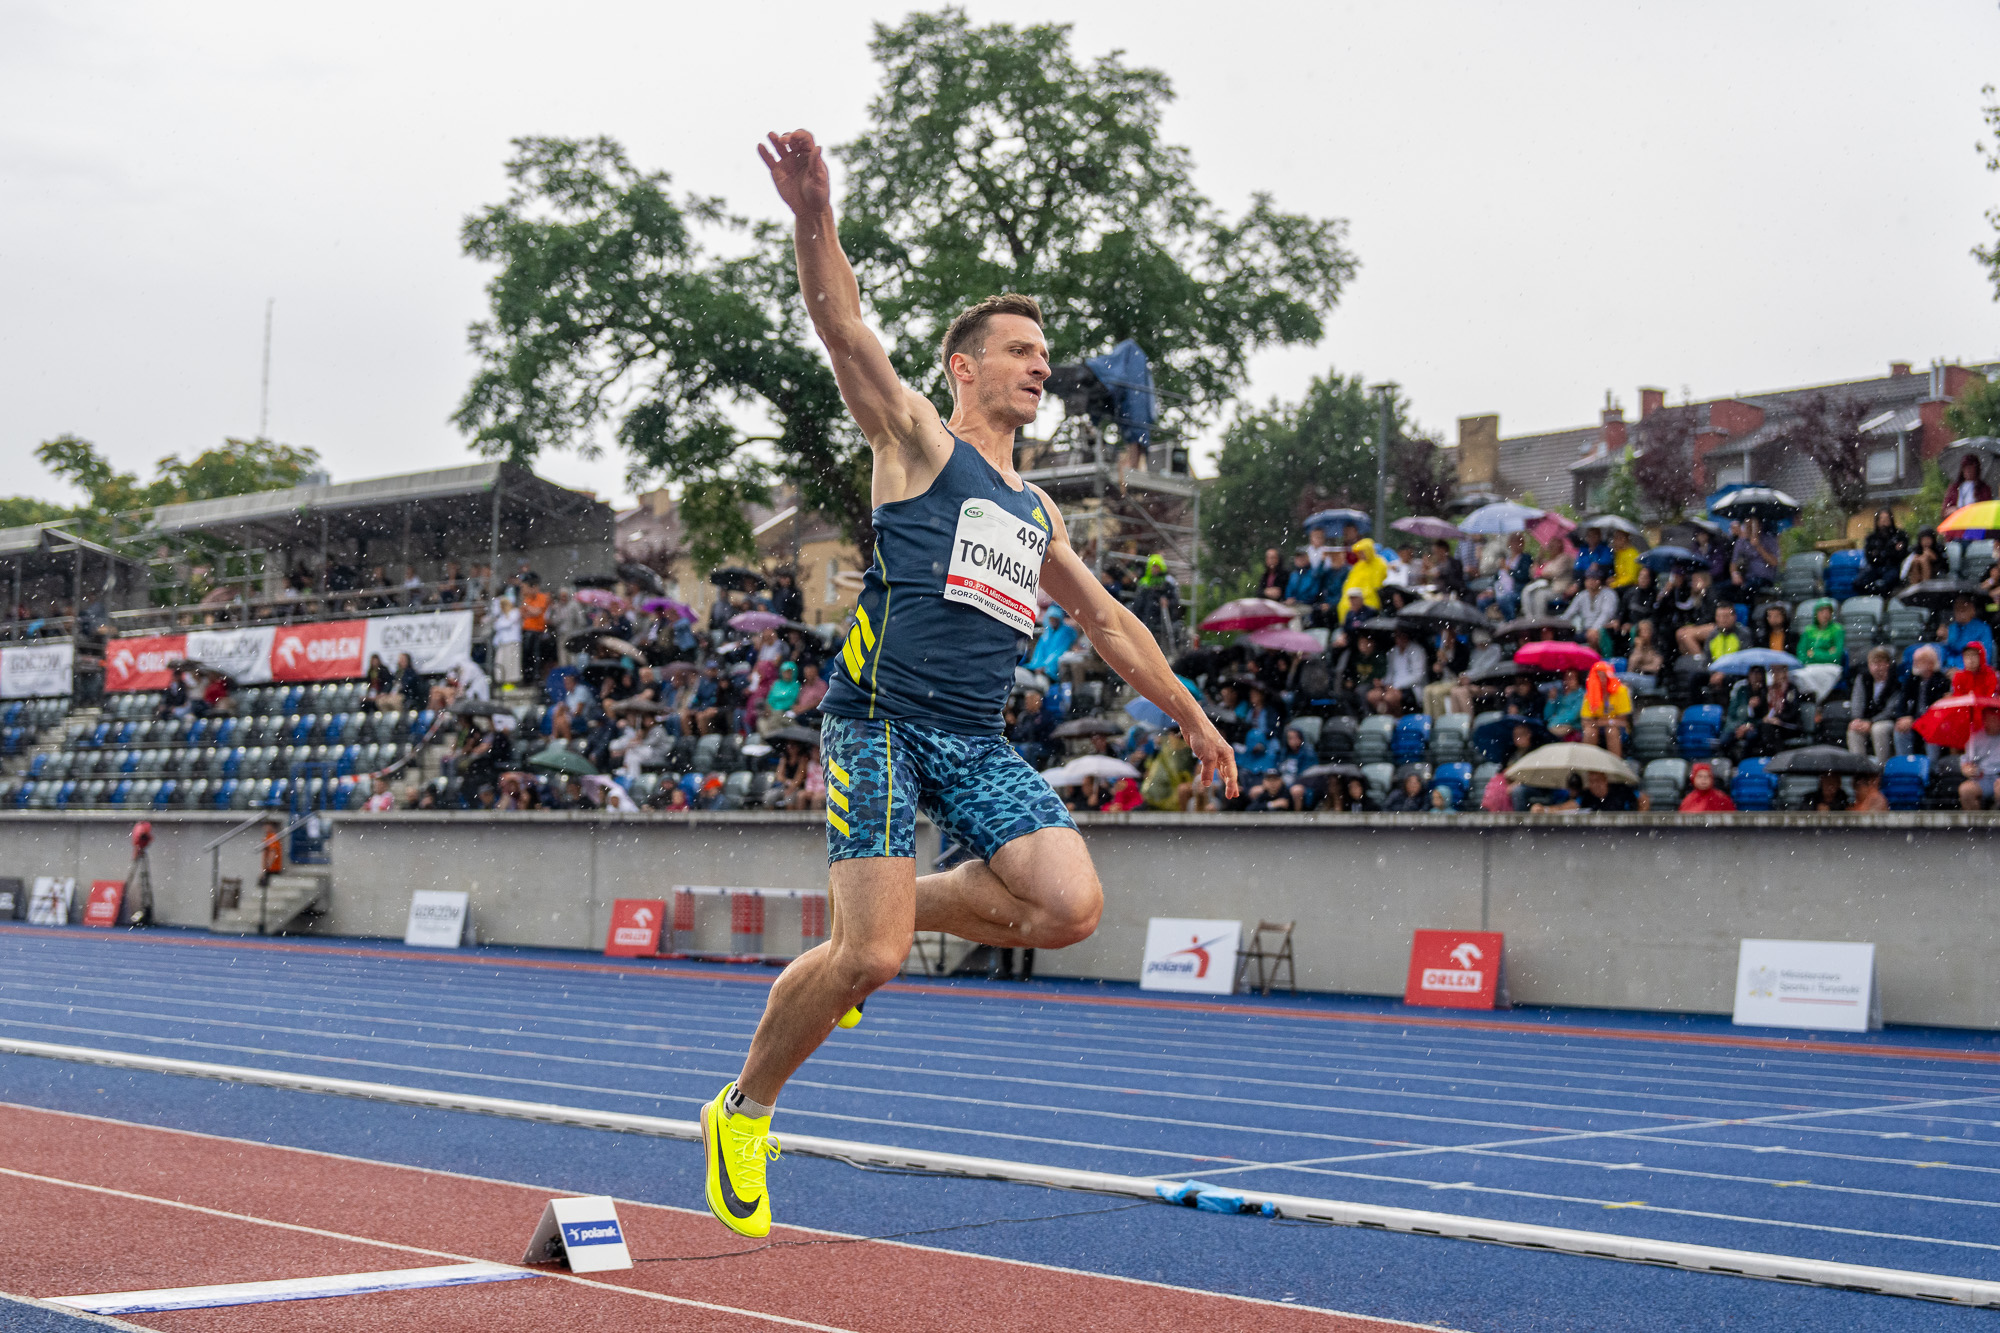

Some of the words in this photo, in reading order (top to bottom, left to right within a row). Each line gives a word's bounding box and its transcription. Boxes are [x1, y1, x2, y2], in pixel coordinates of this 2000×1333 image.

[1016, 526, 1045, 557] 496
[960, 538, 1039, 599] TOMASIAK
[964, 579, 975, 588] 99.
[976, 583, 989, 595] PZLA
[950, 588, 985, 604] GORZÓW
[984, 599, 1024, 625] WIELKOPOLSKI
[306, 637, 361, 662] ORLEN
[1427, 973, 1476, 987] ORLEN
[581, 1226, 617, 1240] polanik
